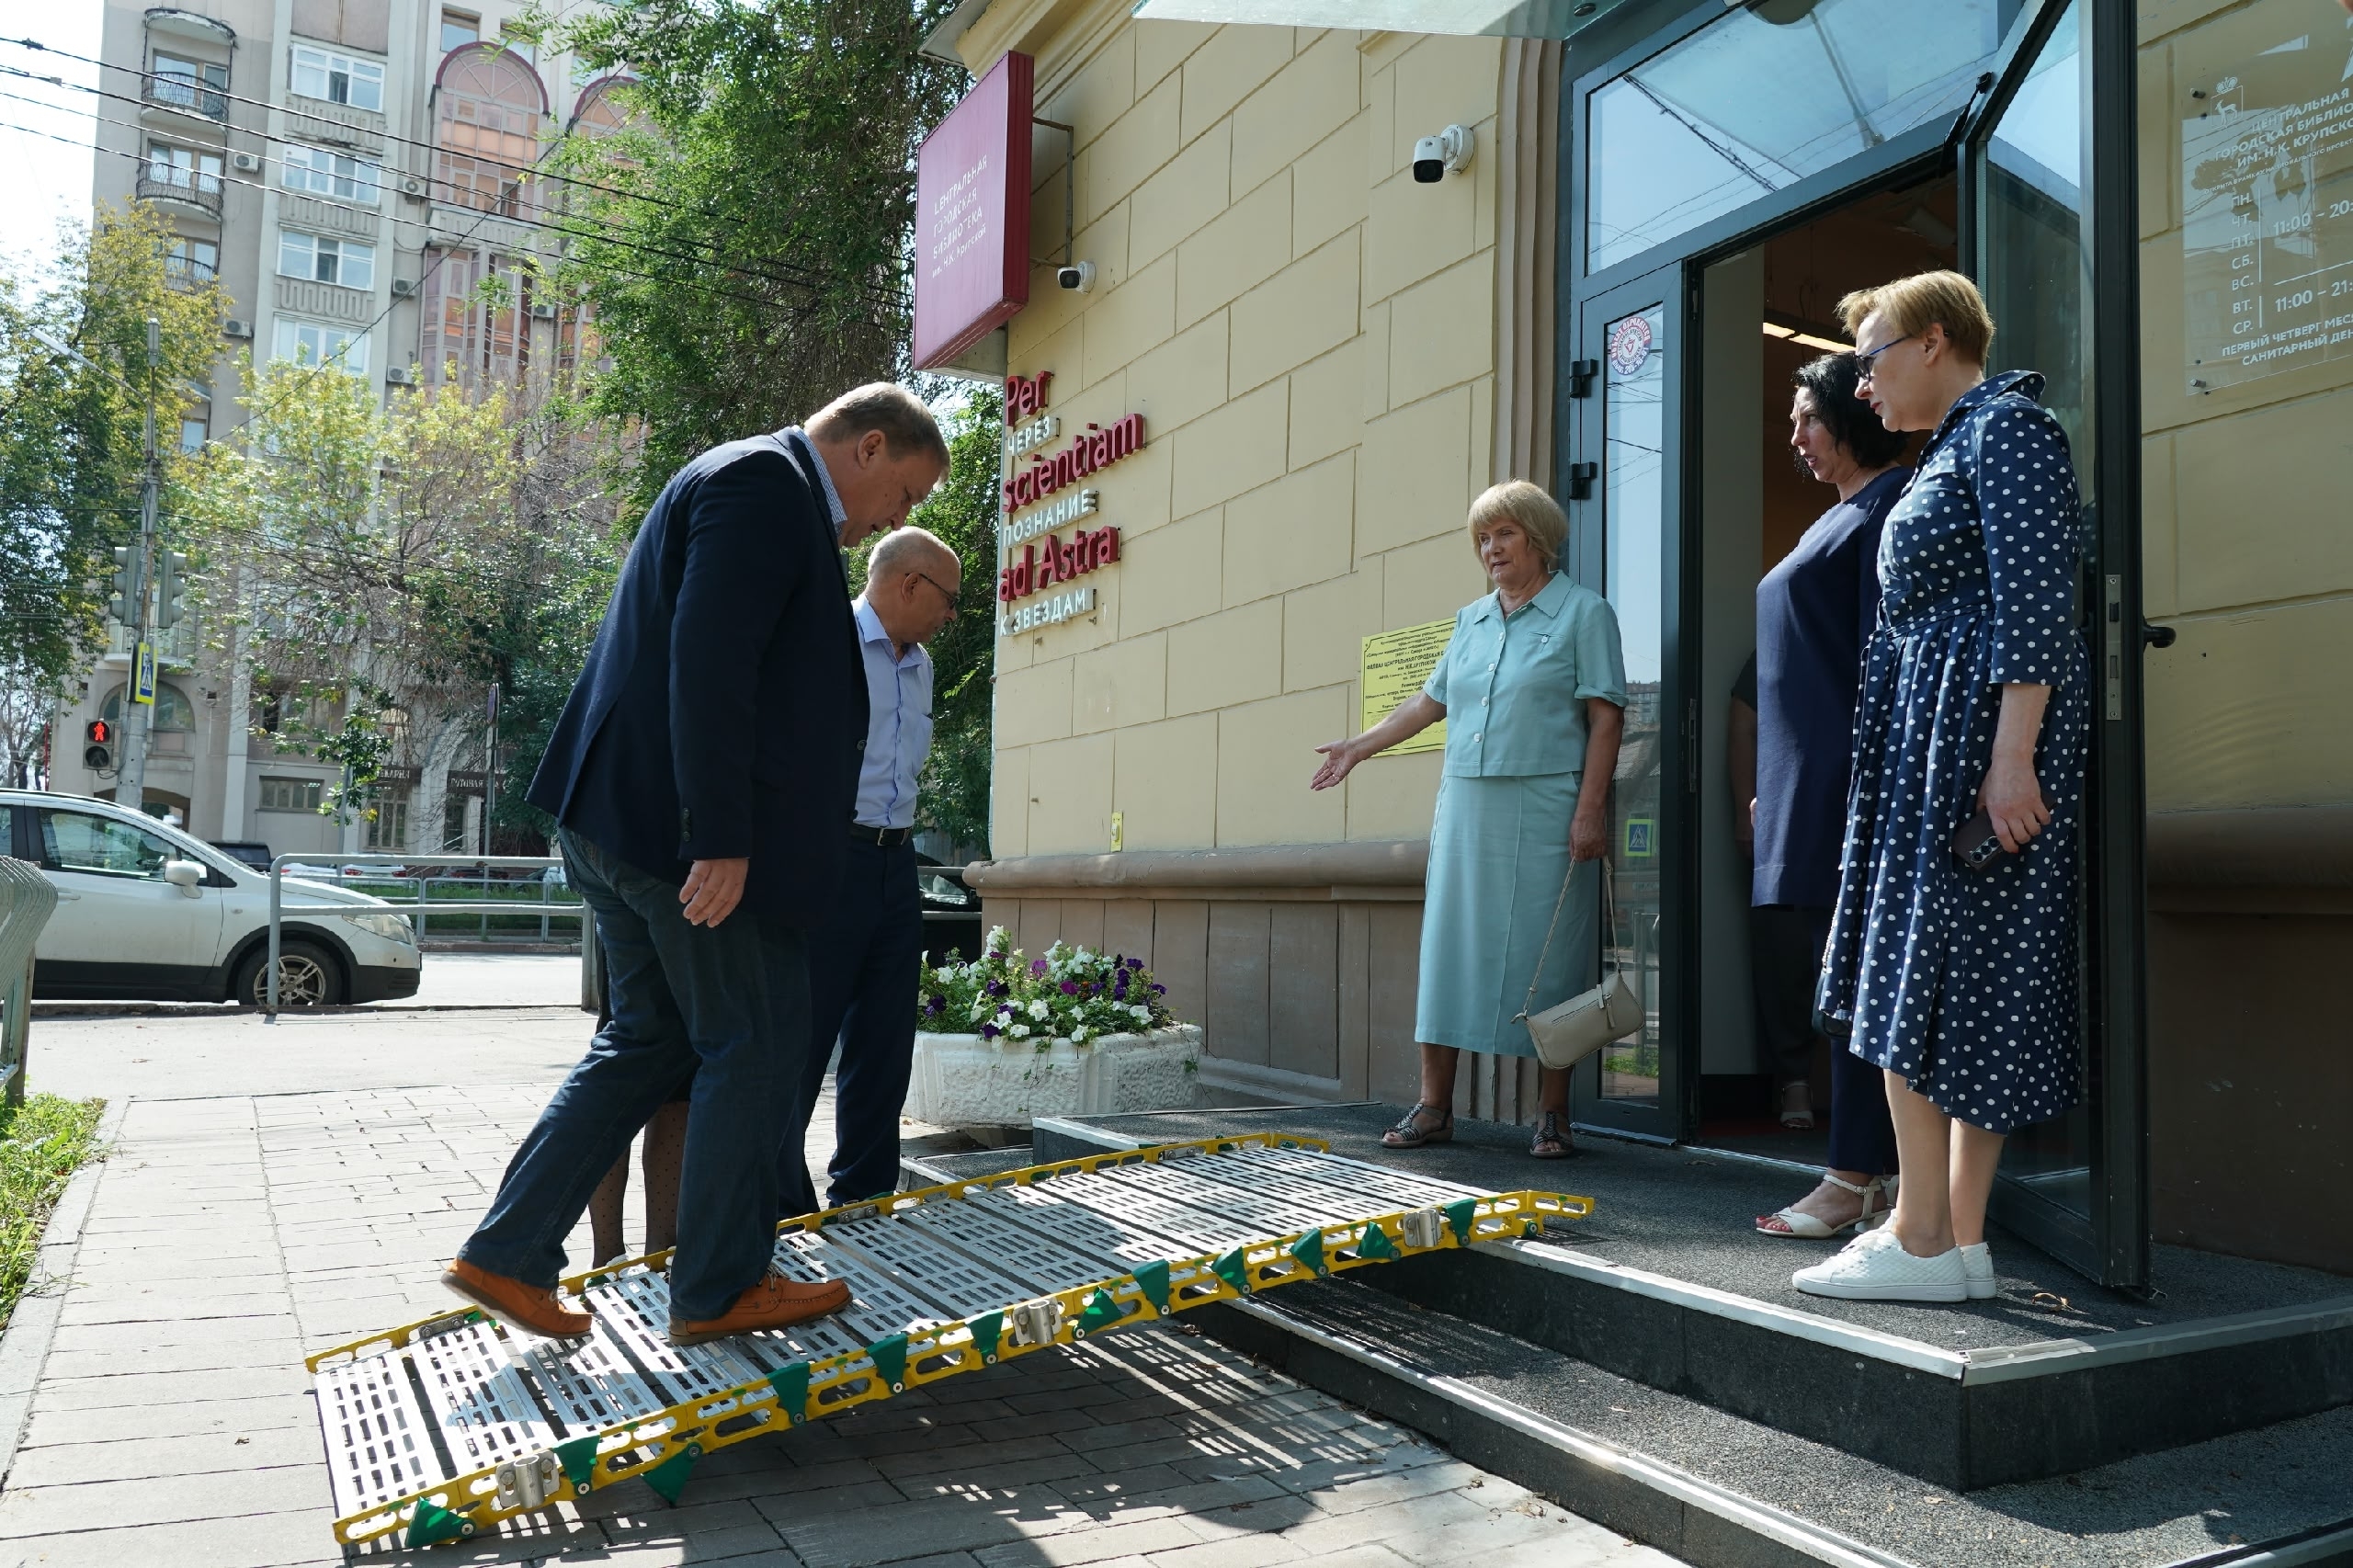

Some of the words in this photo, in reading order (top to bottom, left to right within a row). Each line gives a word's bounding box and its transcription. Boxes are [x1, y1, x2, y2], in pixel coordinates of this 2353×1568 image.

[2252, 87, 2349, 132] ЦЕНТРАЛЬНАЯ
[2215, 124, 2294, 161] ГОРОДСКАЯ
[2237, 152, 2261, 168] ИМ.
[934, 153, 987, 216] ЦЕНТРАЛЬНАЯ
[2232, 192, 2254, 207] ПН.
[933, 187, 977, 238] ГОРОДСКАЯ
[2232, 212, 2253, 228] ЧТ.
[2273, 212, 2311, 236] 11:00
[933, 205, 983, 259] БИБЛИОТЕКА
[2231, 233, 2254, 249] ПТ.
[2232, 254, 2255, 270] СБ.
[2232, 275, 2255, 291] ВС.
[2275, 290, 2313, 312] 11:00
[2233, 299, 2253, 314] ВТ.
[2222, 334, 2270, 357] ПЕРВЫЙ
[2272, 322, 2323, 343] ЧЕТВЕРГ
[2324, 312, 2353, 330] МЕС
[2233, 320, 2254, 335] СР.
[2242, 333, 2328, 366] САНИТАРНЫЙ
[1005, 369, 1052, 427] Per
[1007, 415, 1051, 456] ЧЕРЕЗ
[1002, 413, 1144, 514] scientiam
[1003, 488, 1090, 548] ПОЗНАНИЕ
[999, 544, 1035, 602] ad
[1037, 525, 1120, 589] Astra
[999, 615, 1007, 637] К
[1013, 587, 1086, 632] ЗВЕЗДАМ
